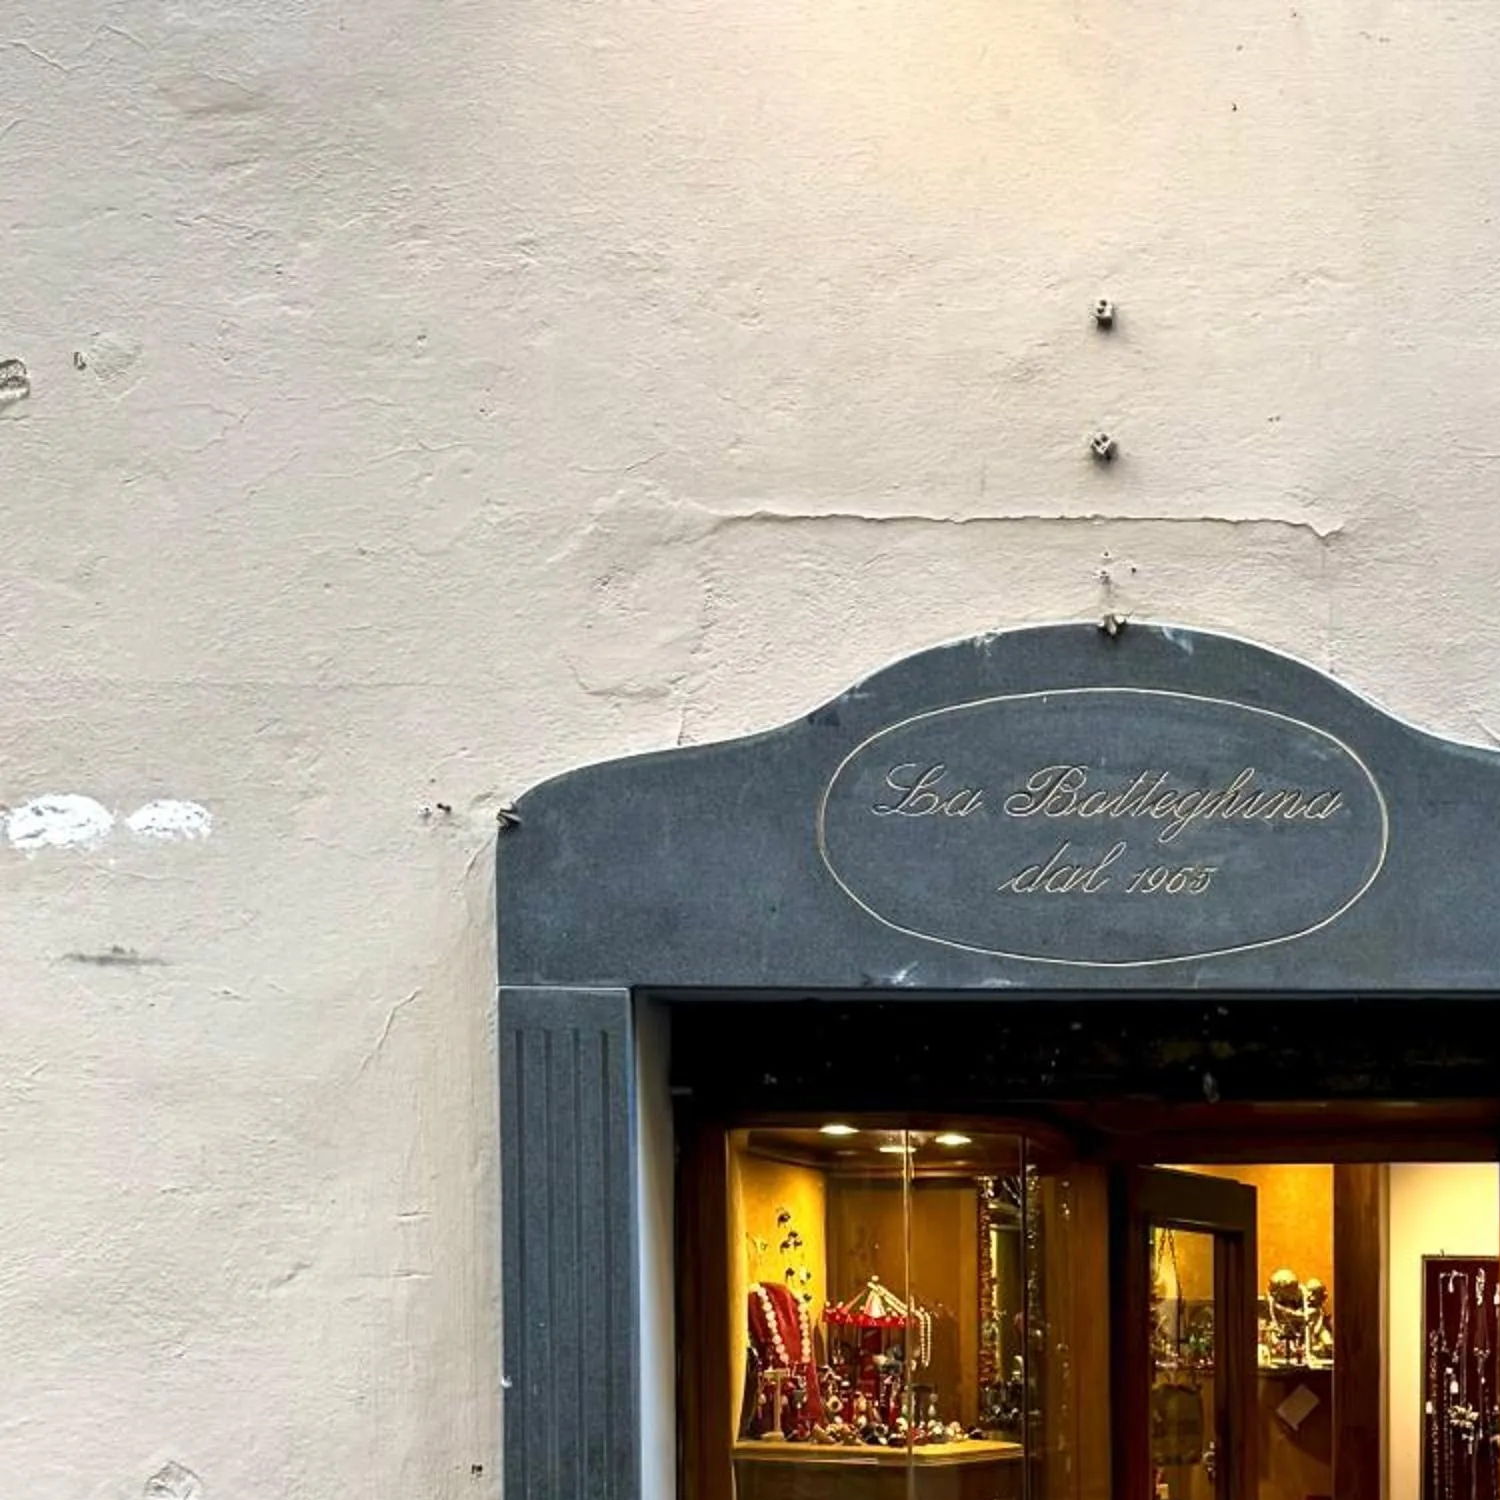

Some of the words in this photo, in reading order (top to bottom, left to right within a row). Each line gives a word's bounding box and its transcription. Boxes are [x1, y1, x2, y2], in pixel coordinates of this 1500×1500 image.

[871, 763, 984, 817] La
[1003, 764, 1343, 843] Botteghina
[998, 841, 1127, 893] dal
[1126, 866, 1218, 894] 1965
